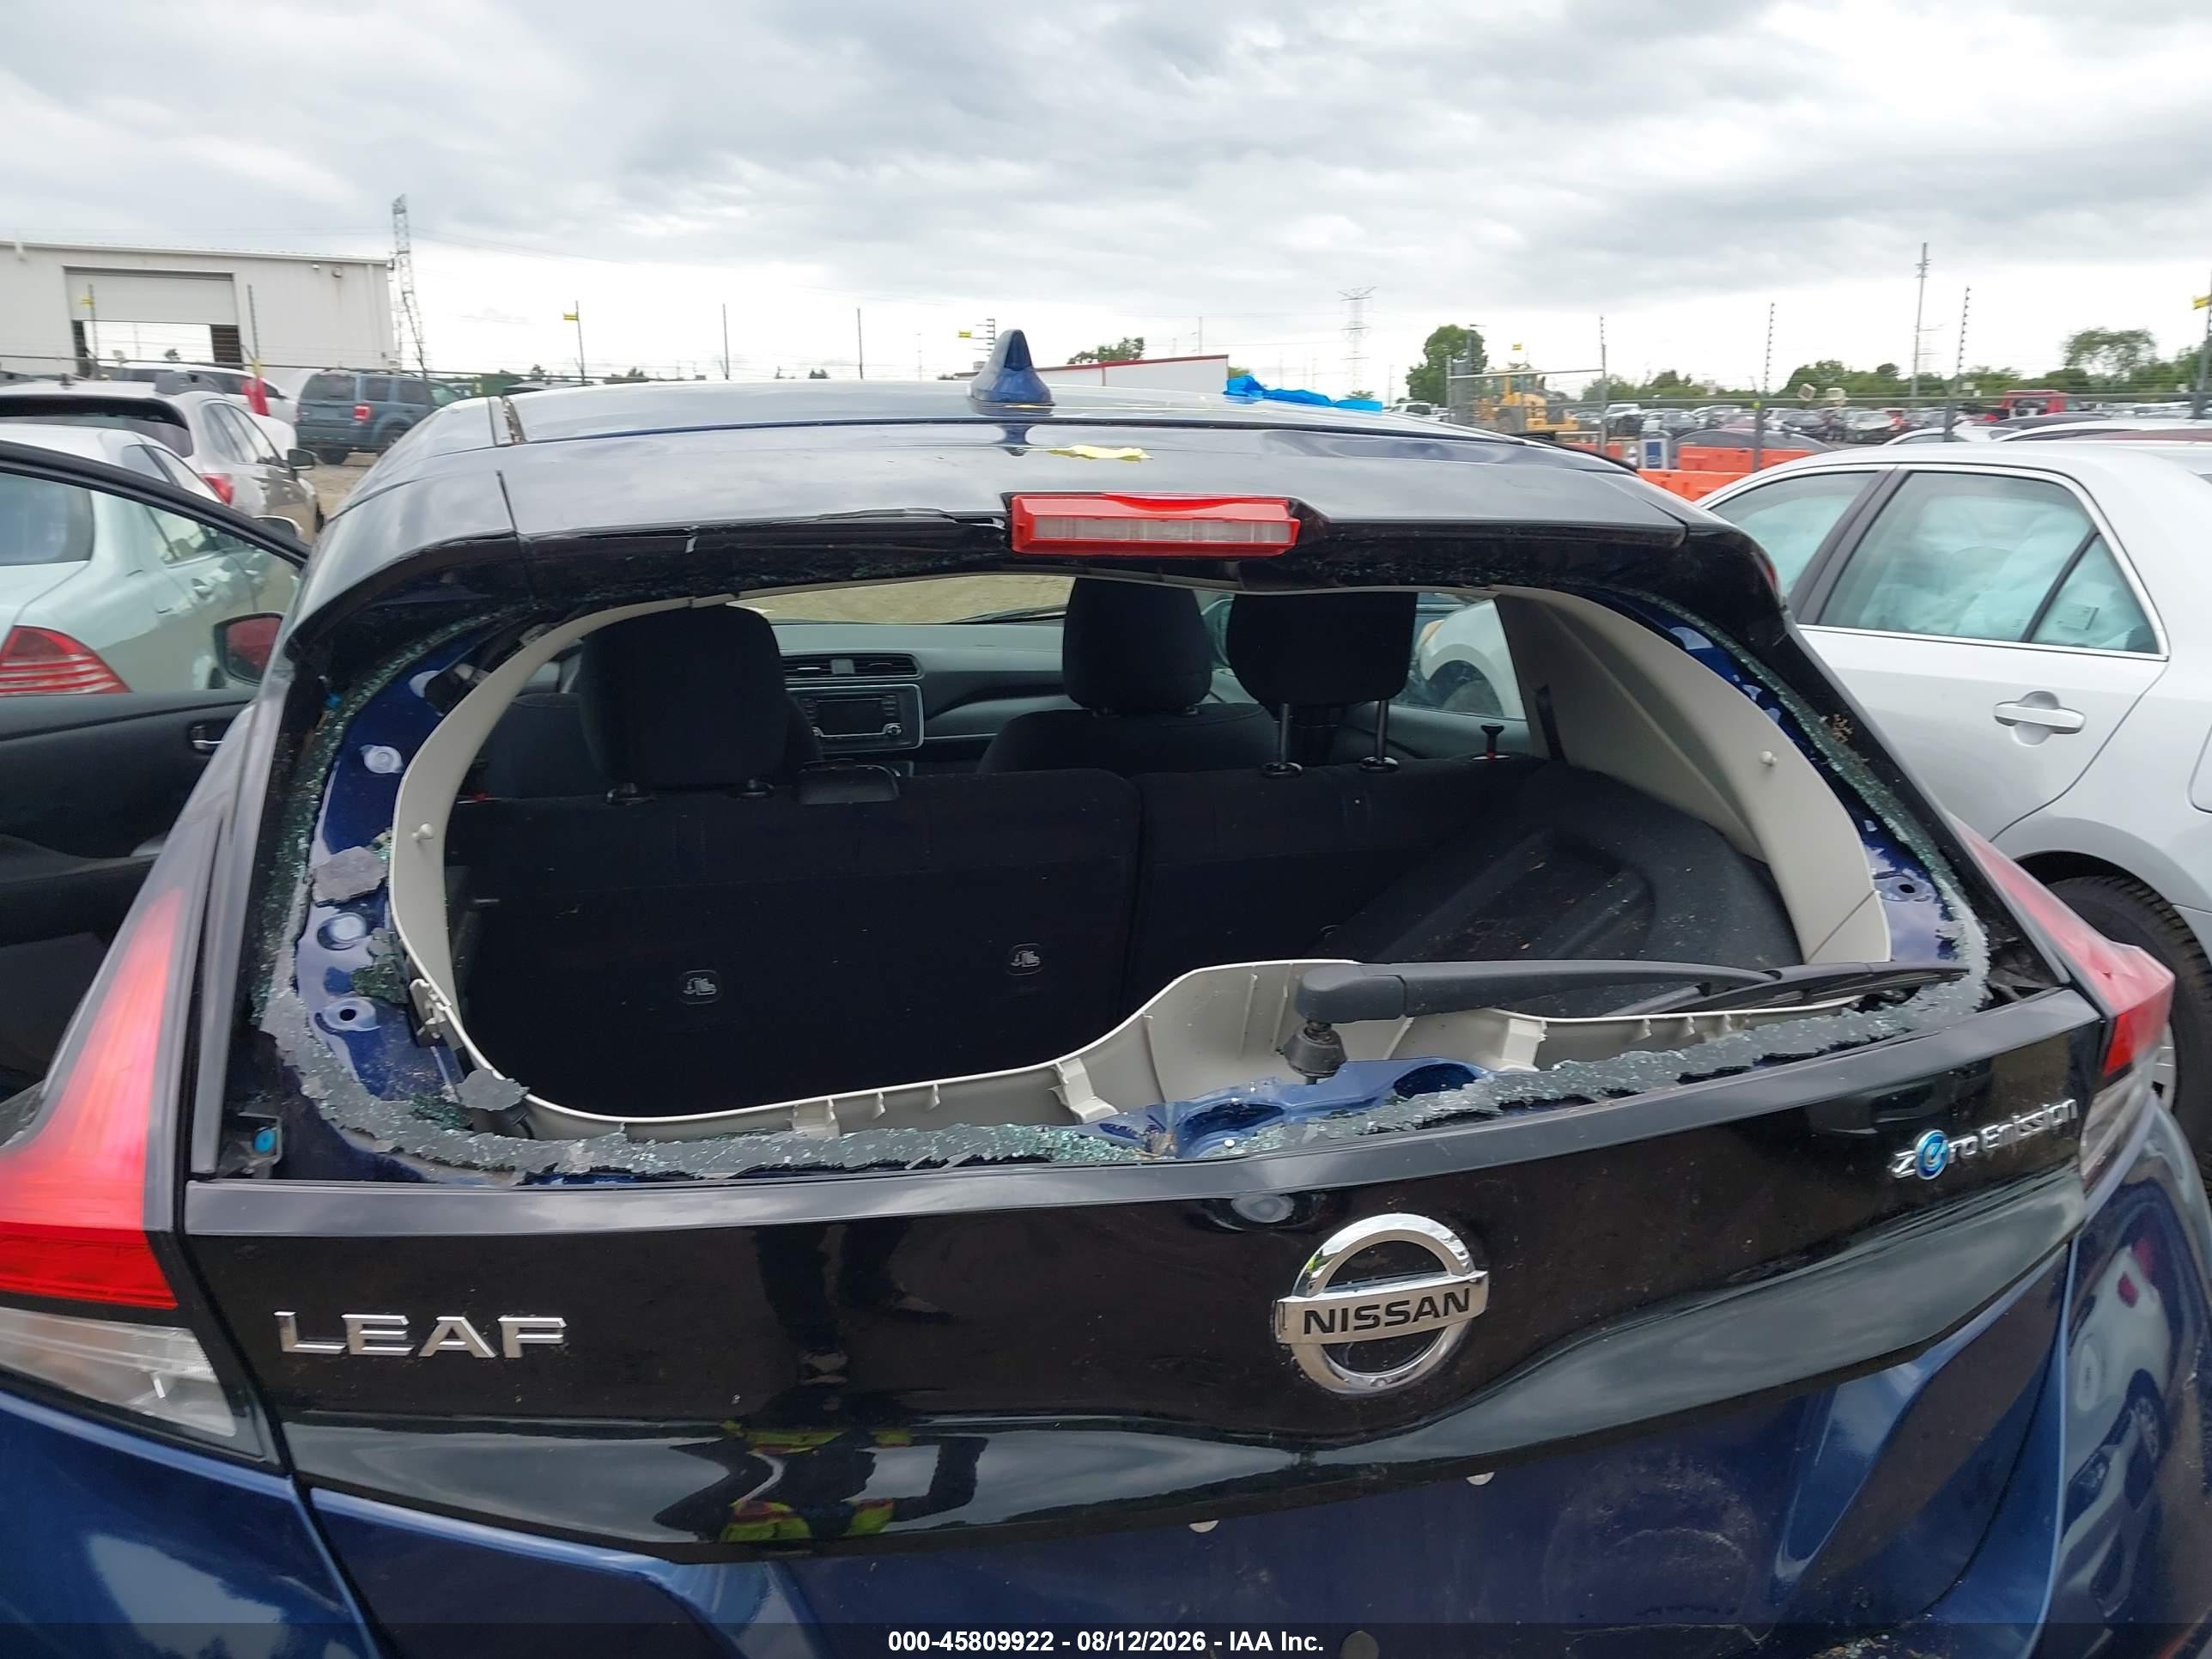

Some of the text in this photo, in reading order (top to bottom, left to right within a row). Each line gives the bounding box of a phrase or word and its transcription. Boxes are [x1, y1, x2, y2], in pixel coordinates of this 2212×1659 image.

[1980, 1098, 2078, 1150] Emission
[1303, 1287, 1470, 1334] NISSAN
[273, 1311, 568, 1358] LEAF
